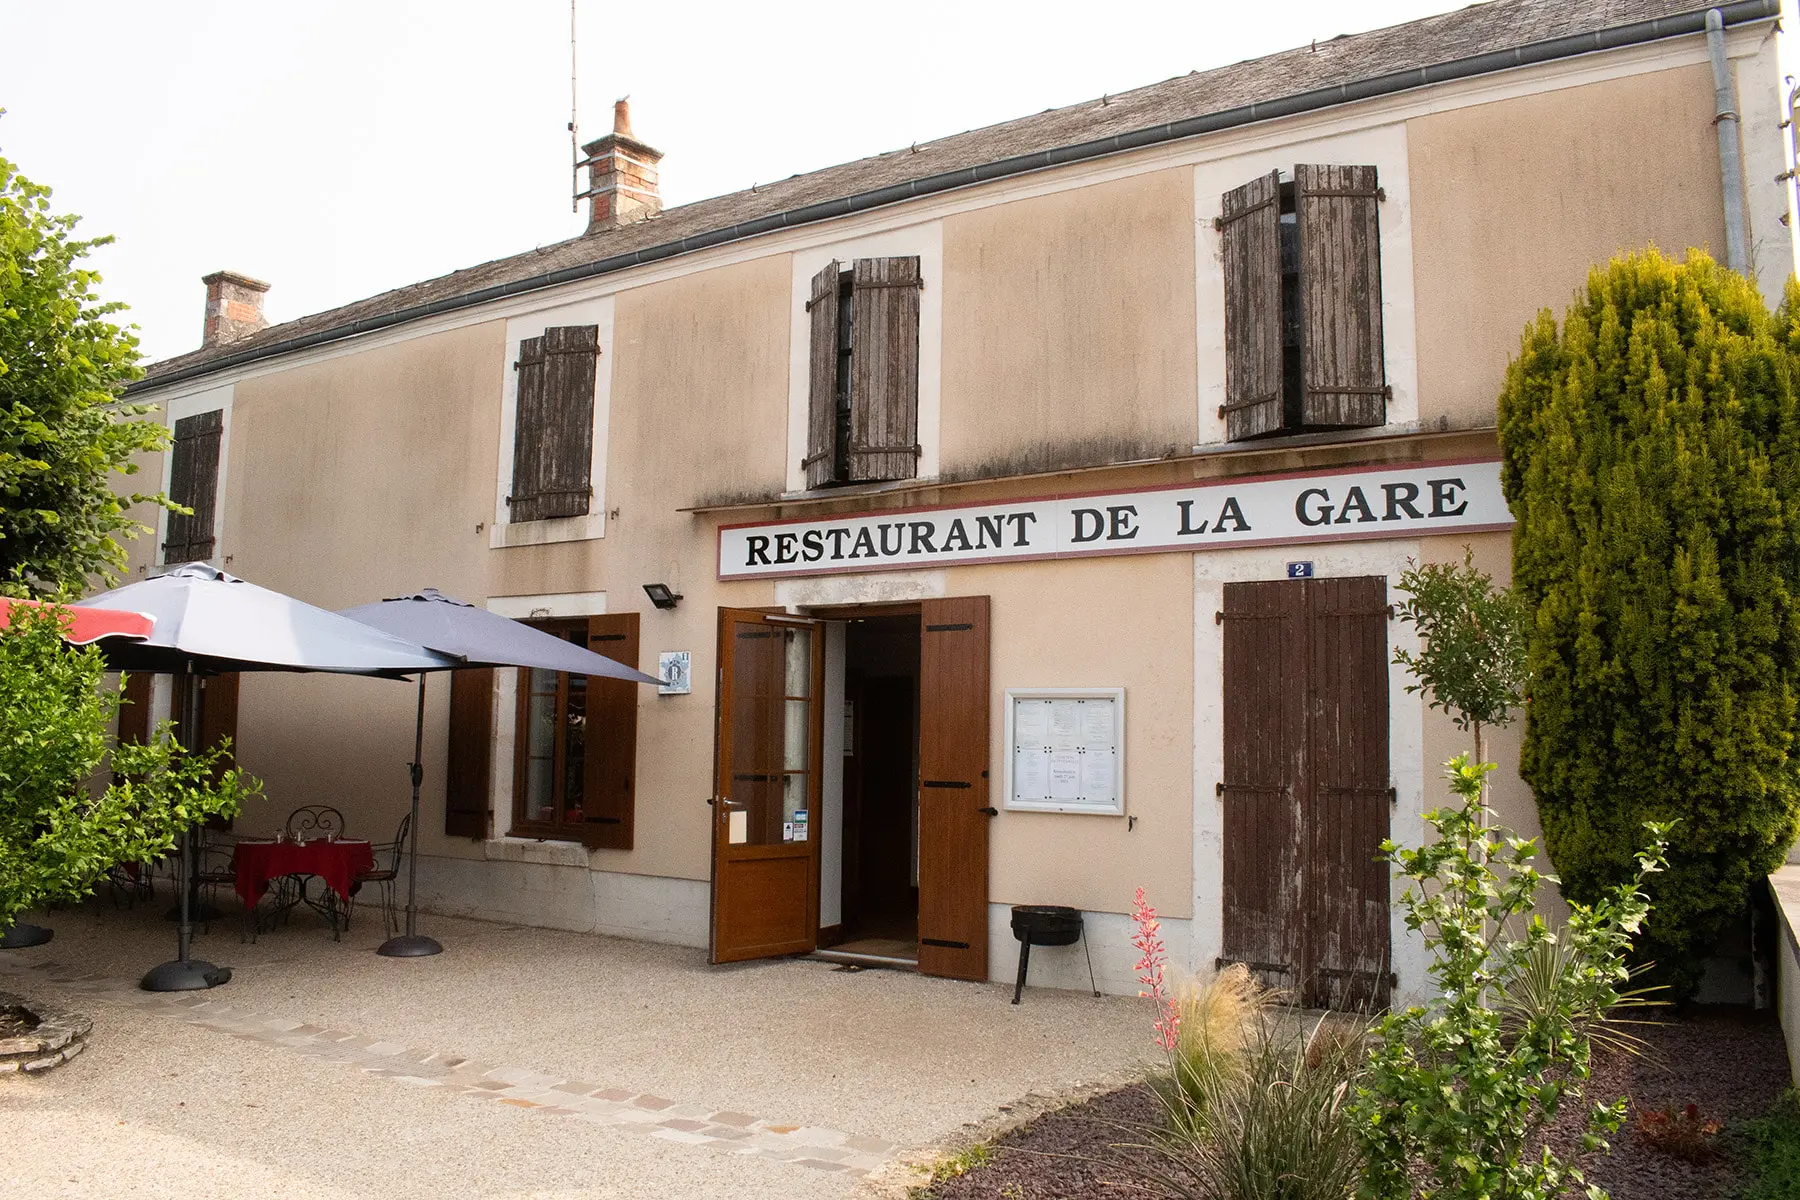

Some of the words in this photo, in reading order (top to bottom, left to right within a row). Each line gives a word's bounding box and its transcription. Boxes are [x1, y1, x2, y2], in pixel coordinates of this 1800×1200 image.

[745, 511, 1037, 567] RESTAURANT
[1070, 505, 1140, 543] DE
[1176, 496, 1252, 536] LA
[1295, 477, 1469, 527] GARE
[1295, 564, 1305, 576] 2
[671, 666, 678, 681] R
